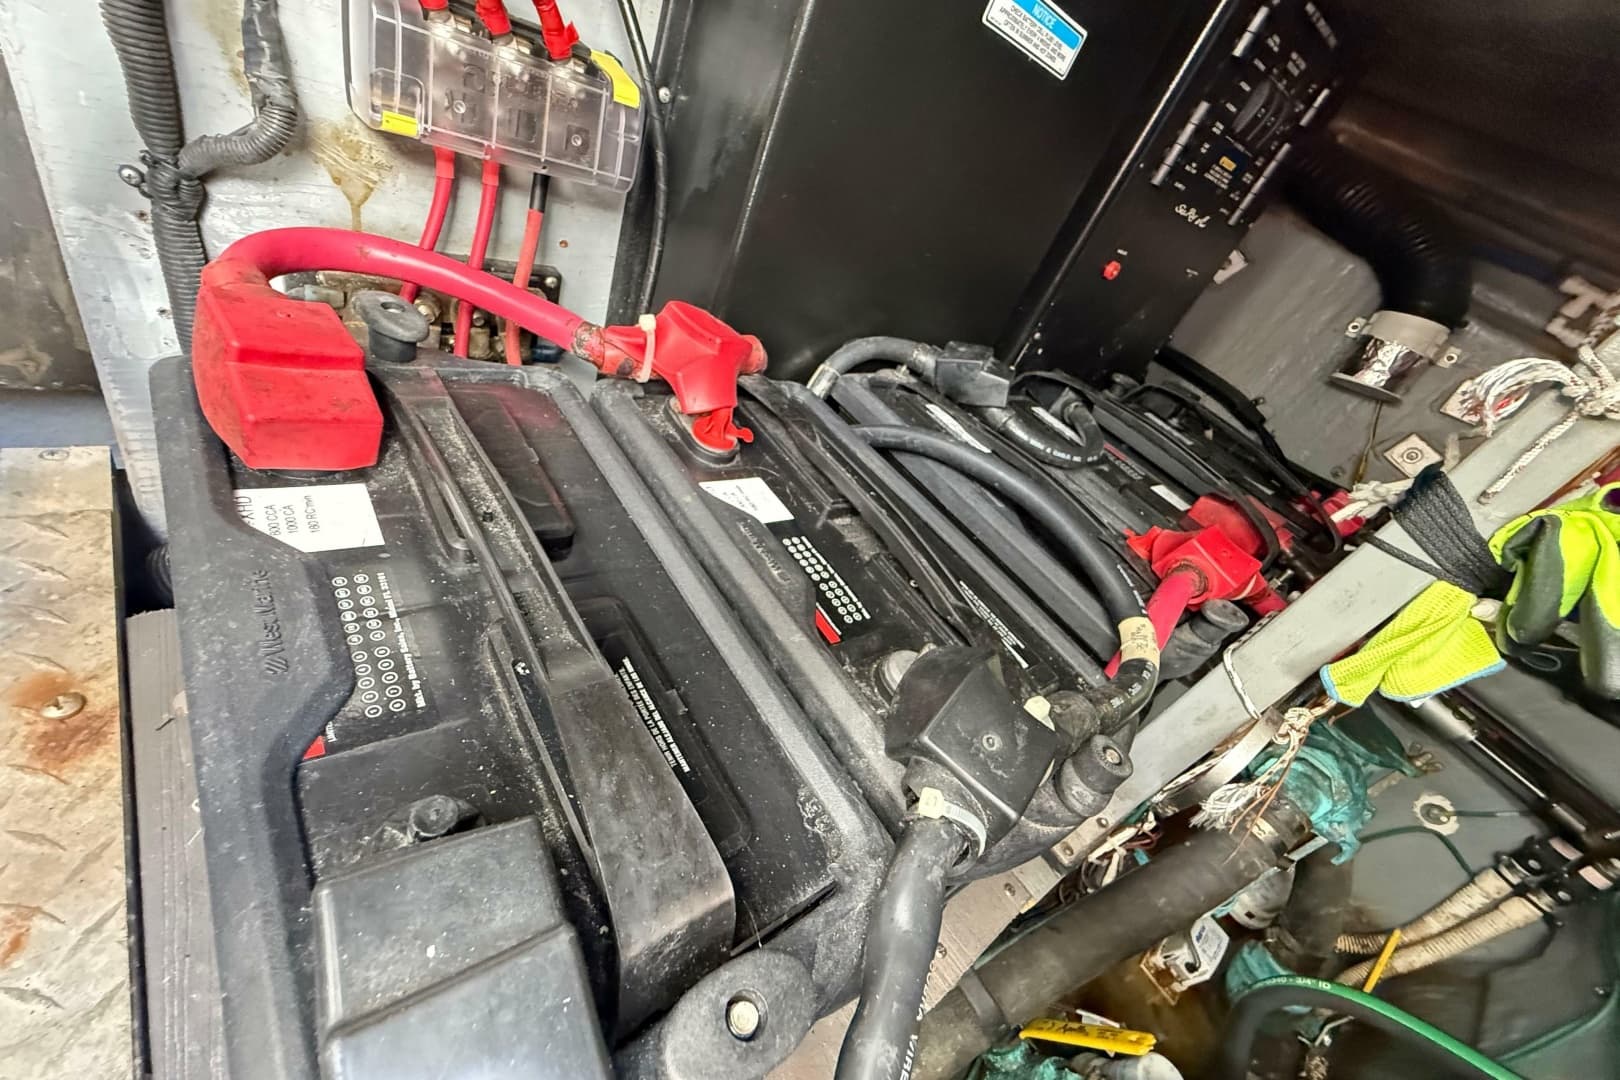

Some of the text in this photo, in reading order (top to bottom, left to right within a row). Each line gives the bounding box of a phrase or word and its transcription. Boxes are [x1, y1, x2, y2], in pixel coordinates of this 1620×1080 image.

[1032, 3, 1057, 29] NOTICE
[264, 504, 278, 521] CCA
[282, 504, 298, 534] 1000 CA
[404, 654, 417, 680] Battery
